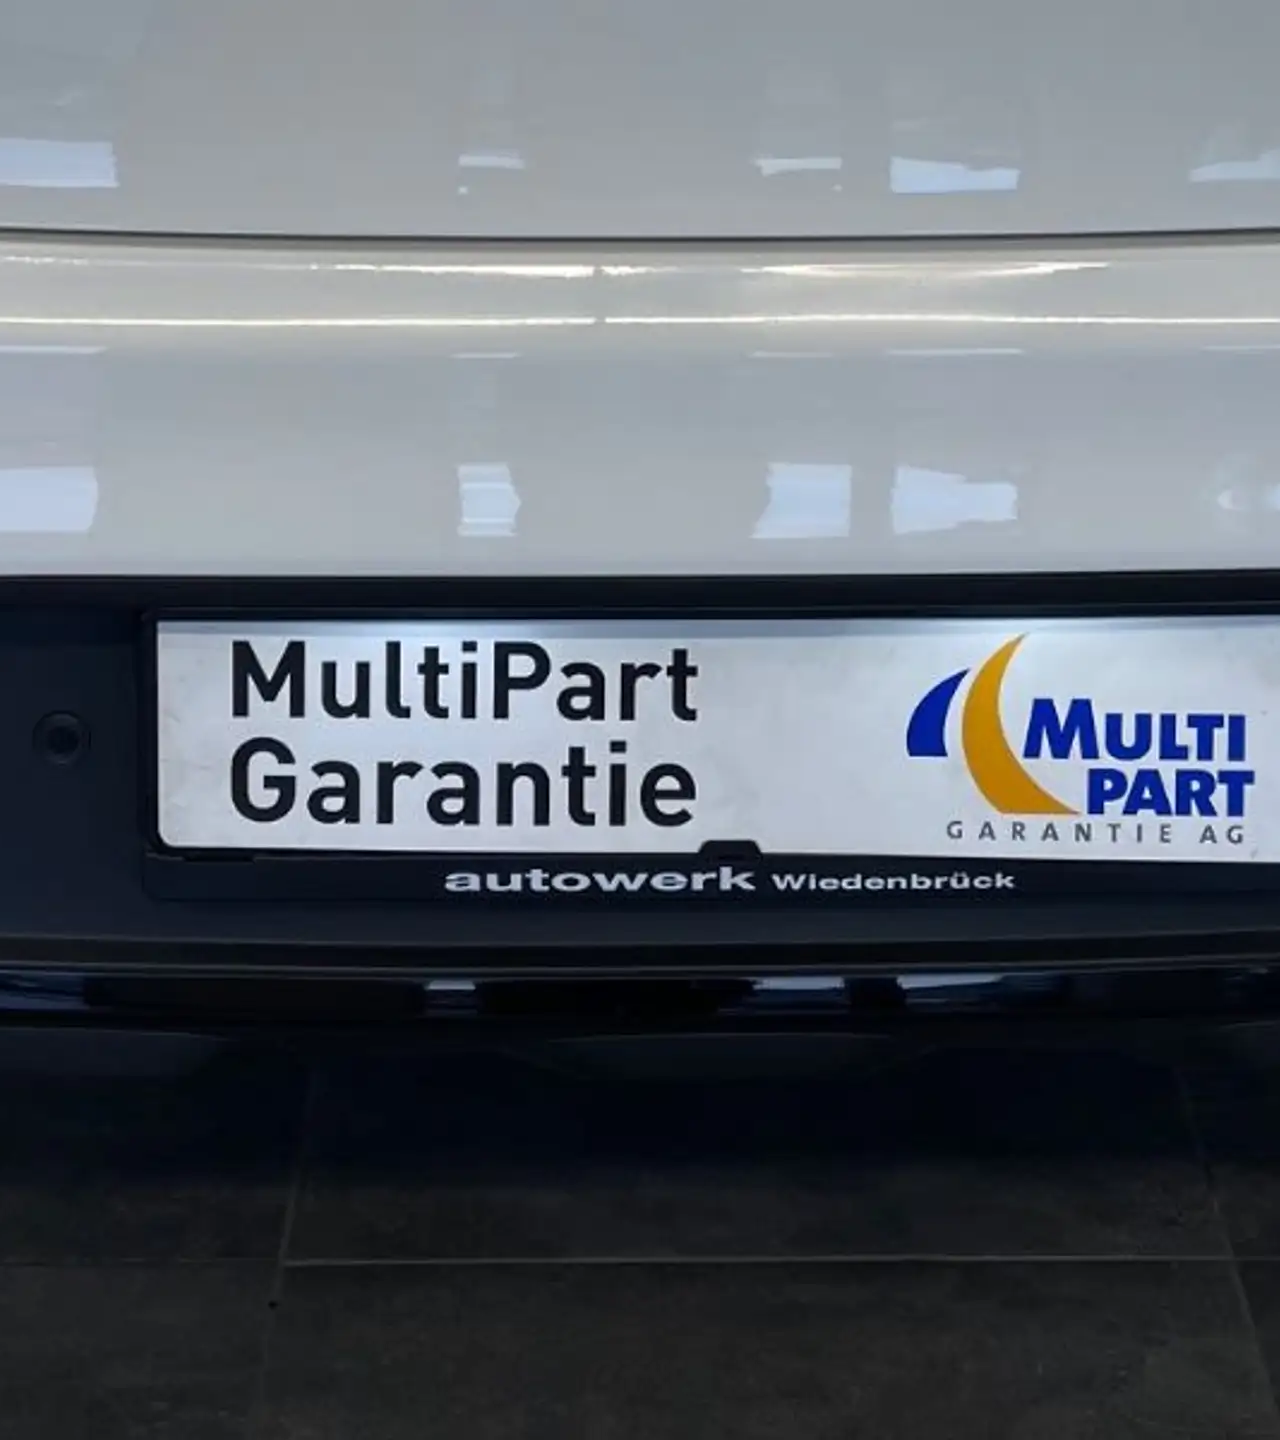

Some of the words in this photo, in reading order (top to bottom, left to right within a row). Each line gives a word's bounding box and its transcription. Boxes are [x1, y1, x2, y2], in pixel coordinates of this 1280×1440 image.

[232, 640, 699, 723] MultiPart
[1023, 697, 1246, 762] MULTI
[230, 736, 697, 827] Garantie
[1086, 767, 1256, 817] PART
[946, 819, 1173, 844] GARANTIE
[1198, 823, 1244, 845] AG
[444, 866, 756, 892] autowerk
[771, 871, 1015, 891] Wiedenbrück
